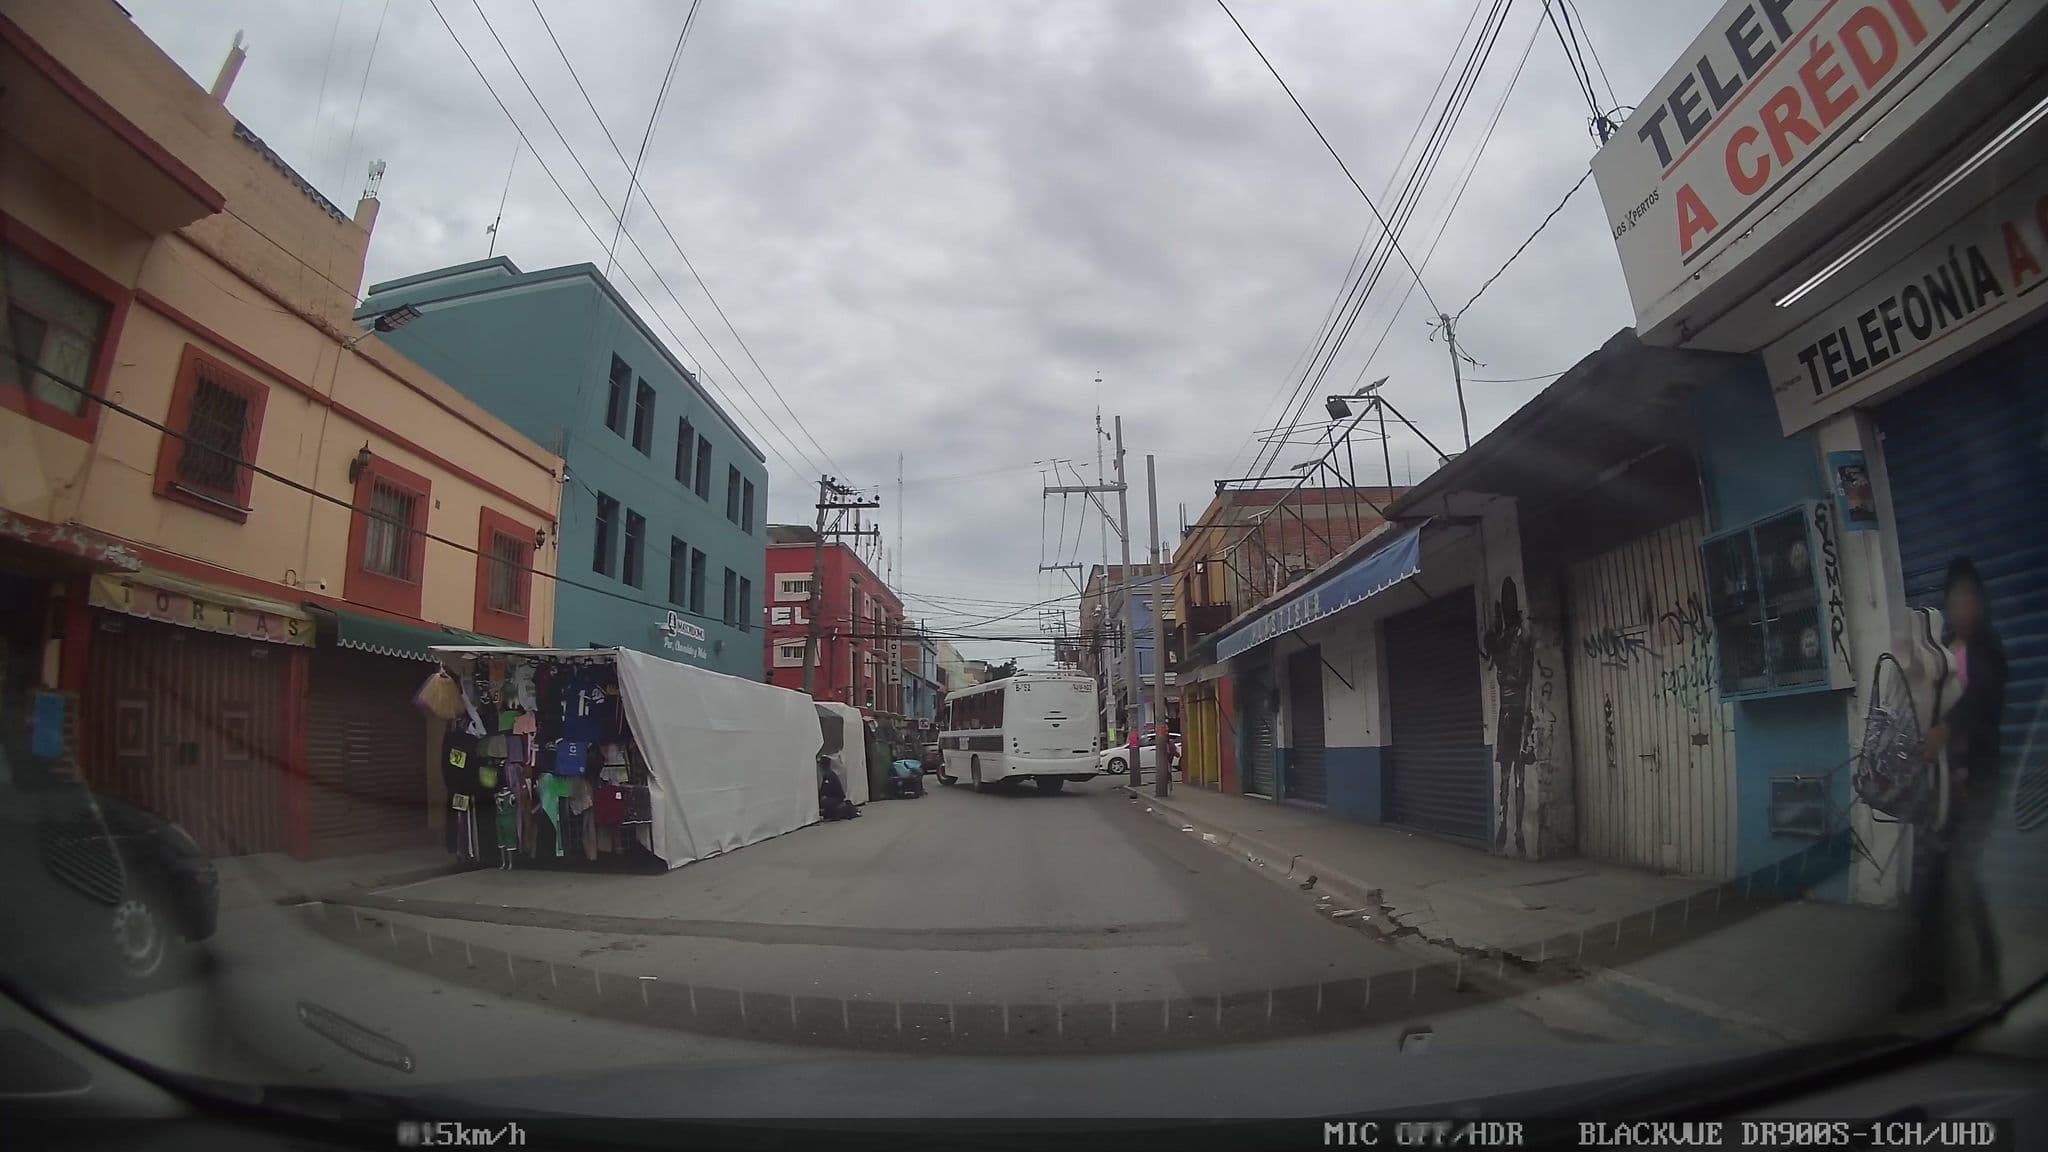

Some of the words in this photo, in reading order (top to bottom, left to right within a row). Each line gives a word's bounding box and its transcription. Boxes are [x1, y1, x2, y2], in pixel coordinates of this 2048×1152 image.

[1675, 183, 1719, 256] A
[1725, 0, 1961, 196] CRÉDI
[1798, 243, 2004, 396] TELEFONÍA
[2001, 220, 2042, 288] A
[121, 582, 299, 637] TORTAS
